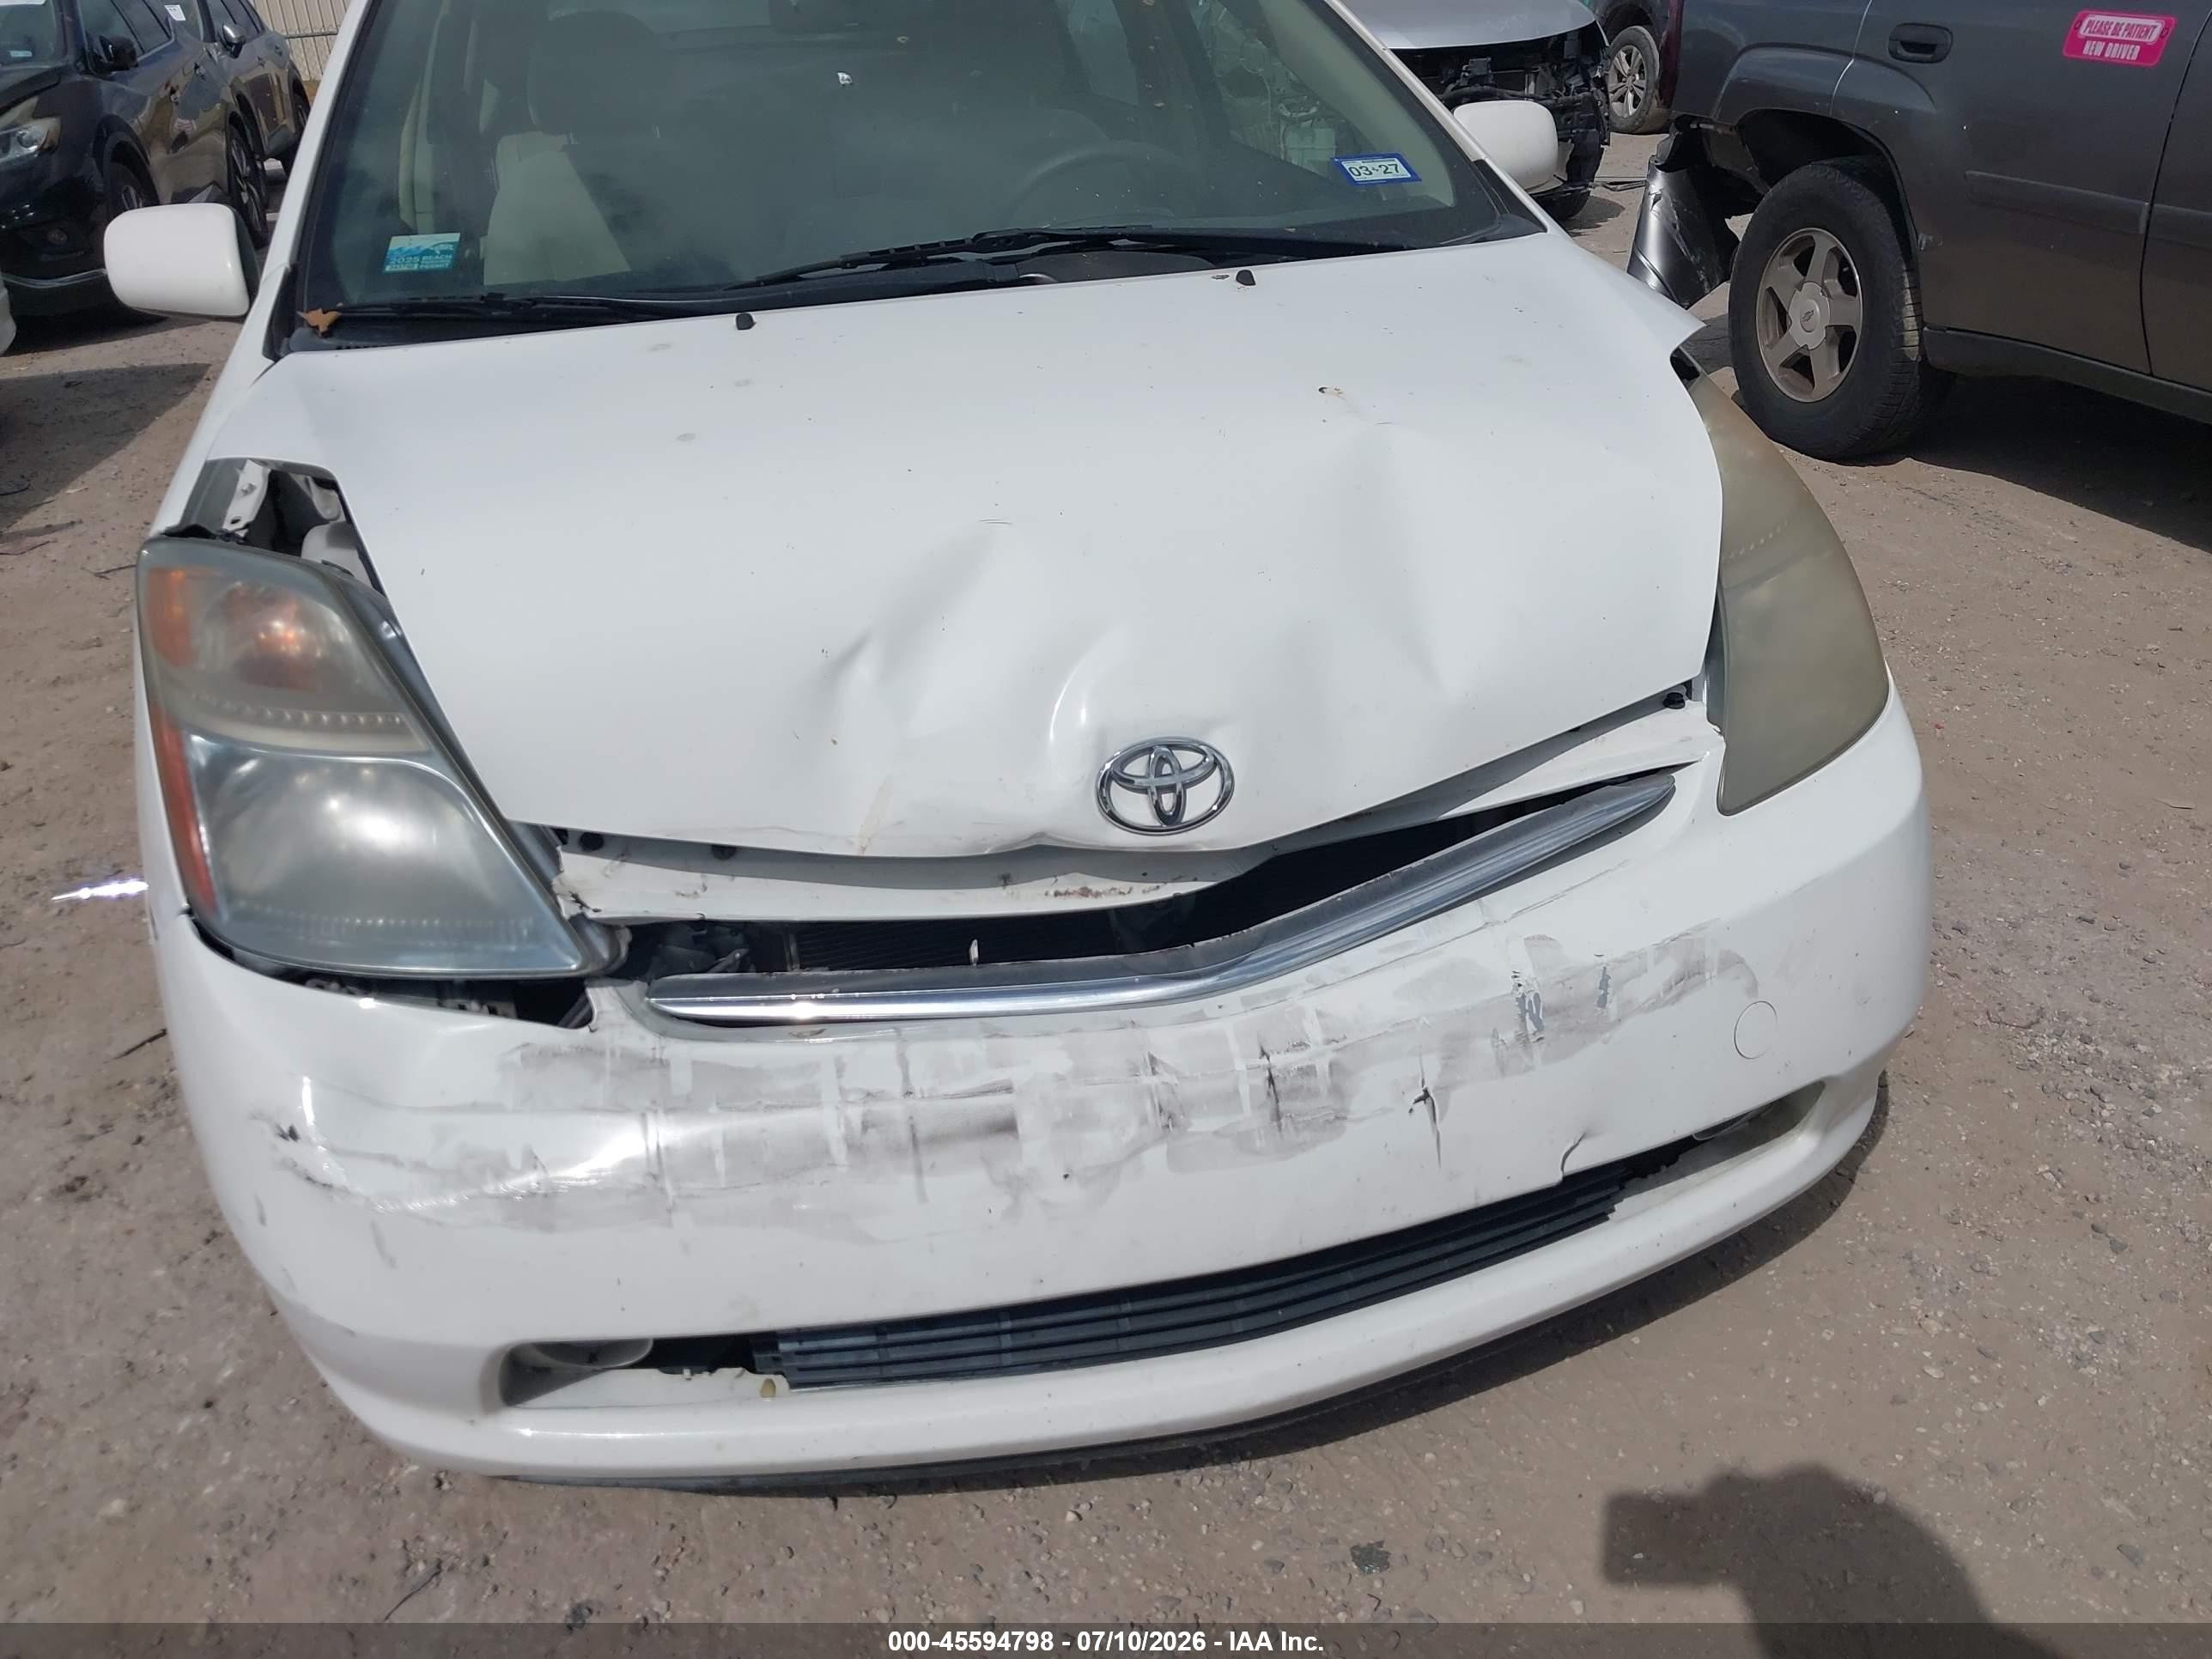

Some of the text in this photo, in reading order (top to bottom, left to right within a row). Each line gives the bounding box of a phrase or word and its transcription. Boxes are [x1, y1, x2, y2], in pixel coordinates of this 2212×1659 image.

[2083, 20, 2158, 40] PLEASE BE PATIENT
[2082, 40, 2141, 61] NEW DRIVER
